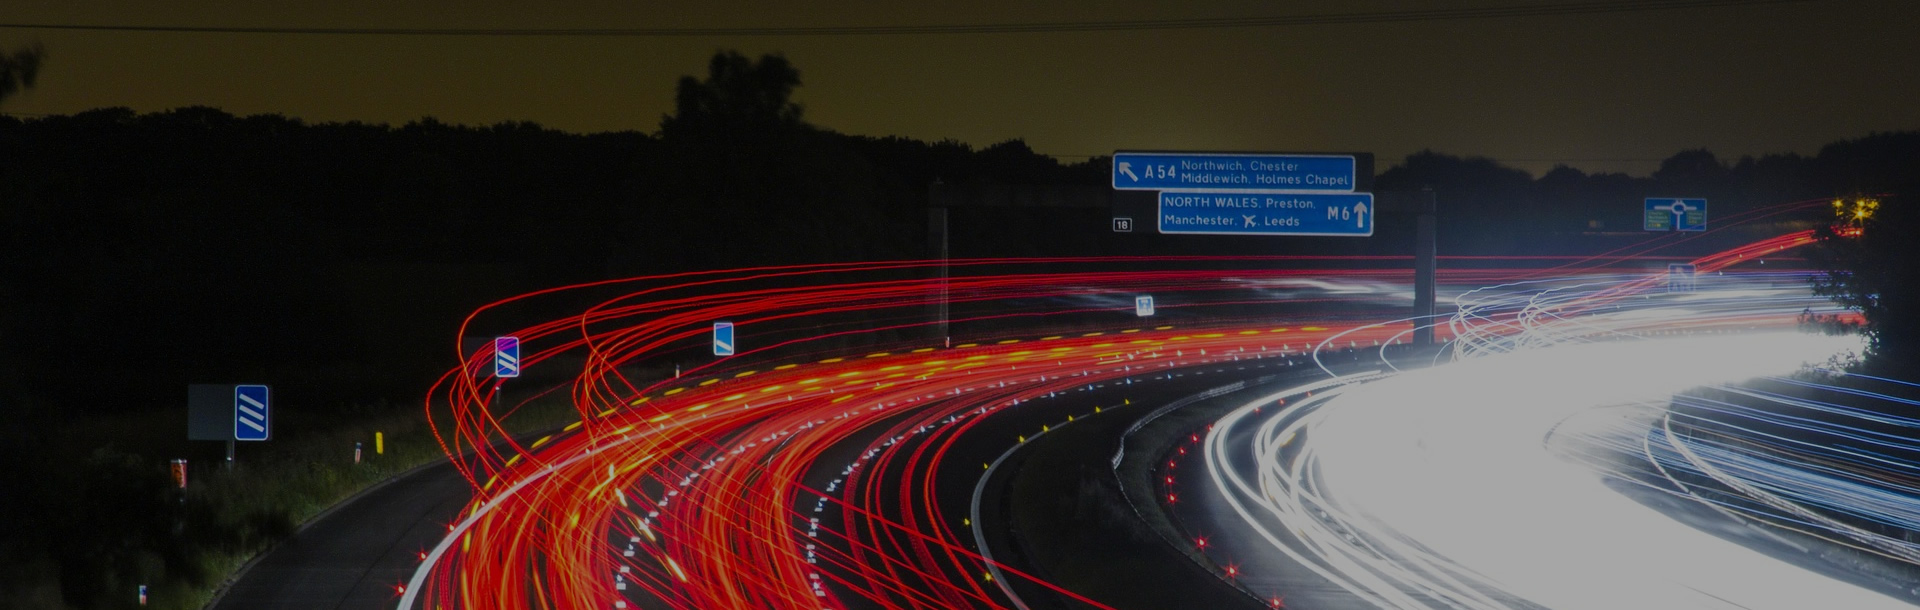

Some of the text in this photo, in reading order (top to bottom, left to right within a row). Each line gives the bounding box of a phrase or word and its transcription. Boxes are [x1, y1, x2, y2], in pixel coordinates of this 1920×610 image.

[1250, 160, 1298, 171] Chester
[1256, 174, 1301, 185] Holmes
[1305, 174, 1348, 187] Chapel
[1165, 197, 1210, 207] NORTH
[1117, 221, 1128, 230] 18
[1265, 216, 1300, 226] Leeds
